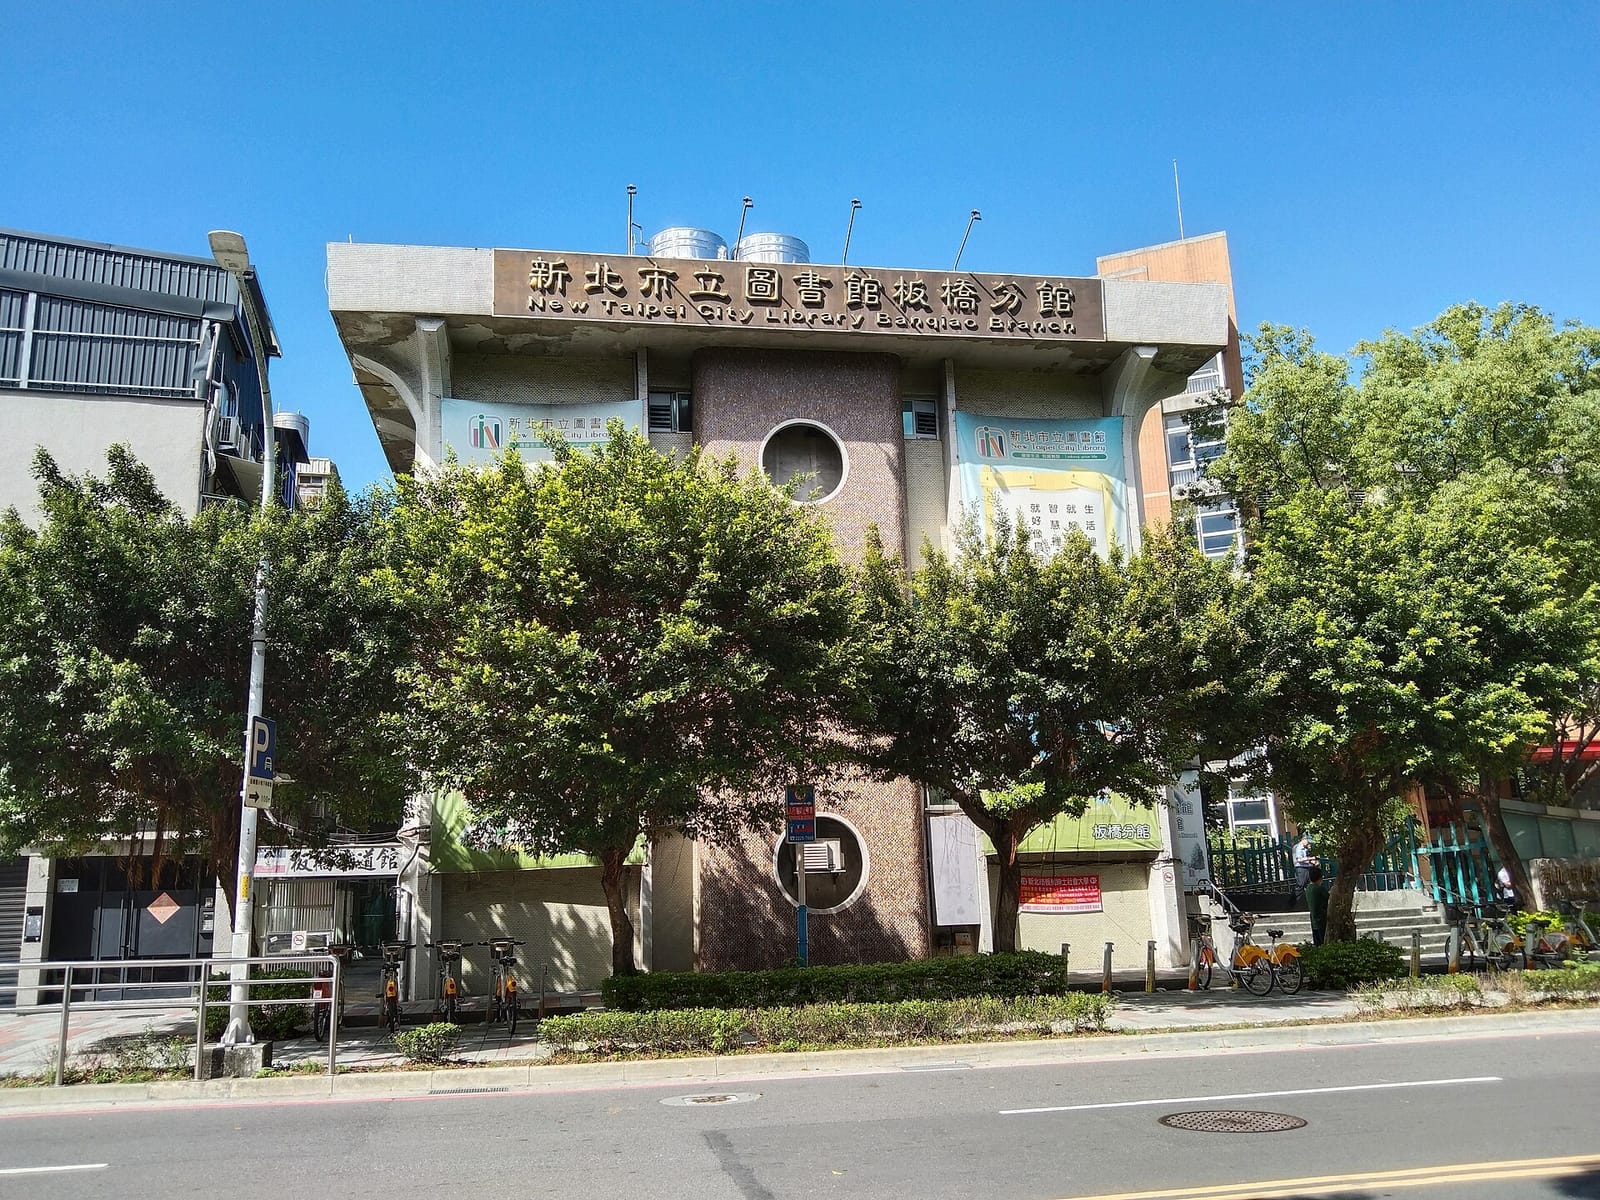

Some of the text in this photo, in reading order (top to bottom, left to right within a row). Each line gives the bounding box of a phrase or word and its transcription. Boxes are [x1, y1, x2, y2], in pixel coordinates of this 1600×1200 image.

[528, 256, 1076, 317] 新北市立圖書館板橋分館
[528, 296, 1077, 335] New Taipei City Library Banqiao Branch
[508, 417, 617, 430] 新北市立圖書
[1010, 430, 1105, 443] 新北市立圖書館
[1032, 443, 1055, 452] Taipei
[1057, 443, 1074, 452] City
[1077, 444, 1106, 452] Library
[253, 721, 269, 768] P
[1092, 823, 1151, 840] 板橋分館
[289, 847, 399, 873] 板橋道館
